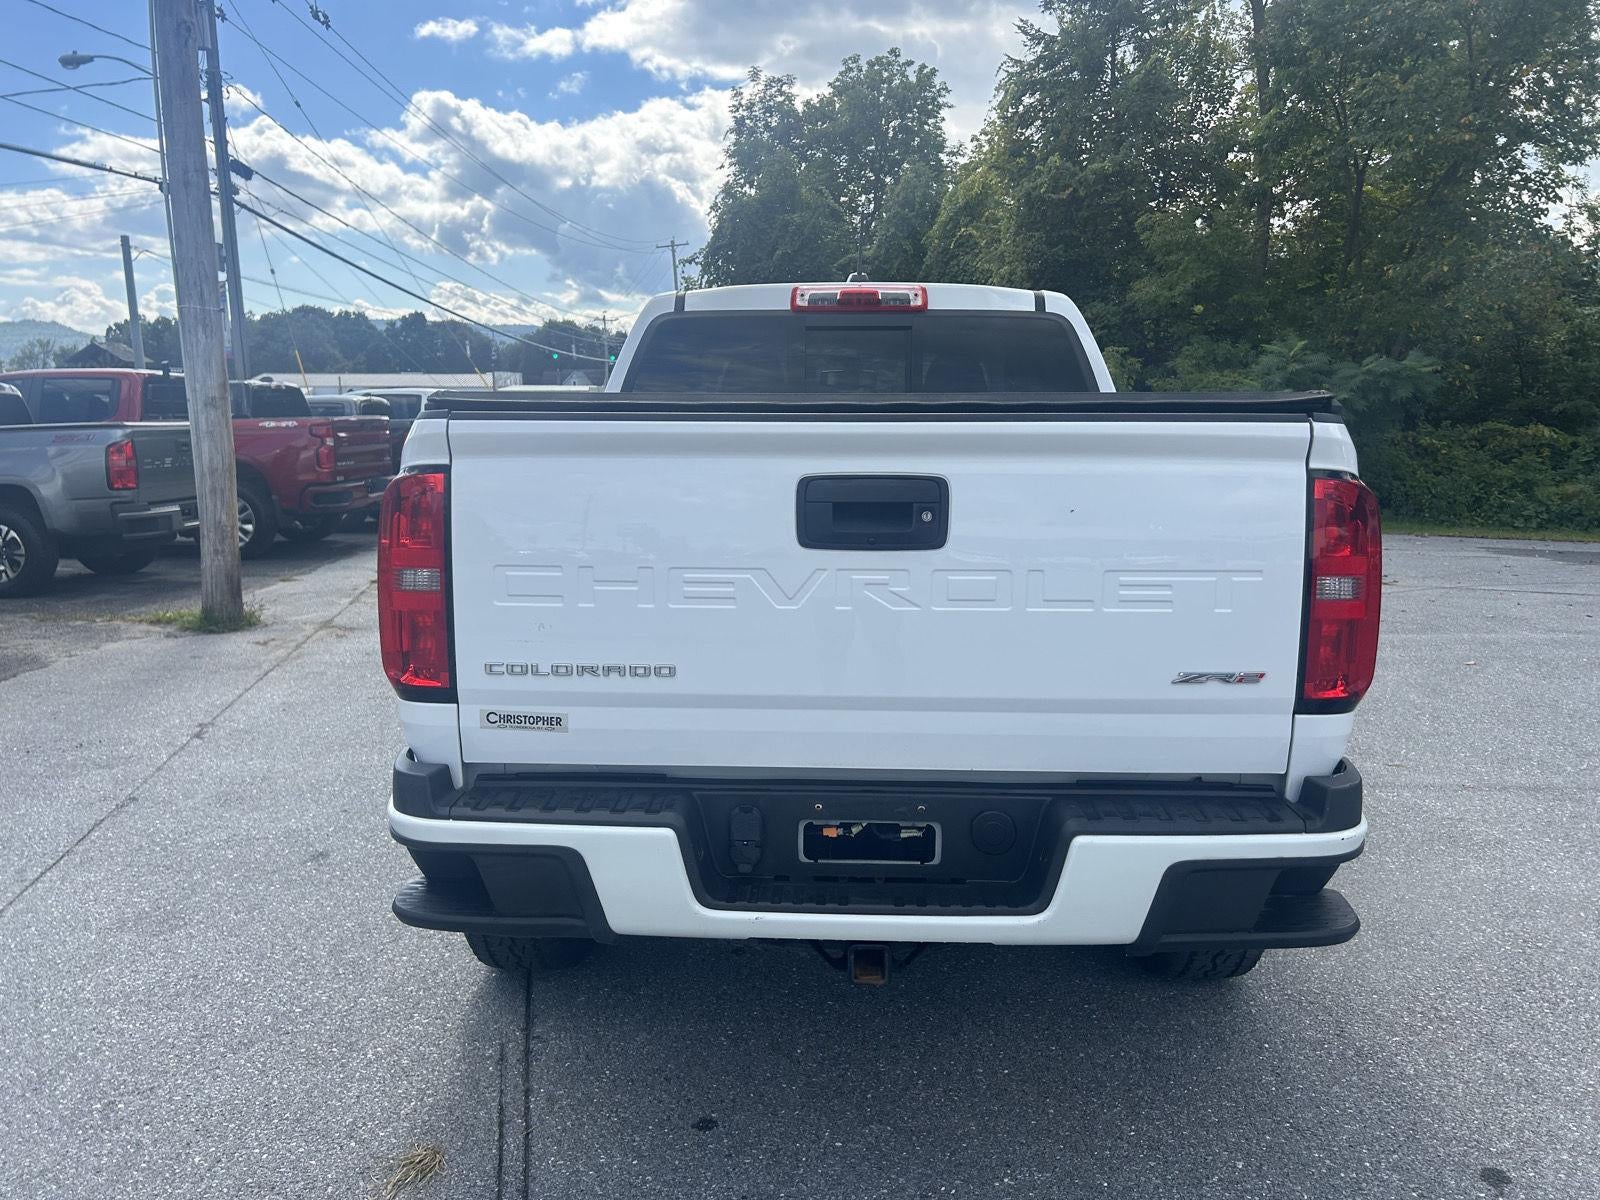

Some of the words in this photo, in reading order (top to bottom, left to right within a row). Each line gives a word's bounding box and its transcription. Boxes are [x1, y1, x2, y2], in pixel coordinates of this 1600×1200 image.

[492, 563, 1265, 613] CHEVROLET
[483, 662, 678, 679] COLORADO
[1170, 671, 1267, 685] ZR2
